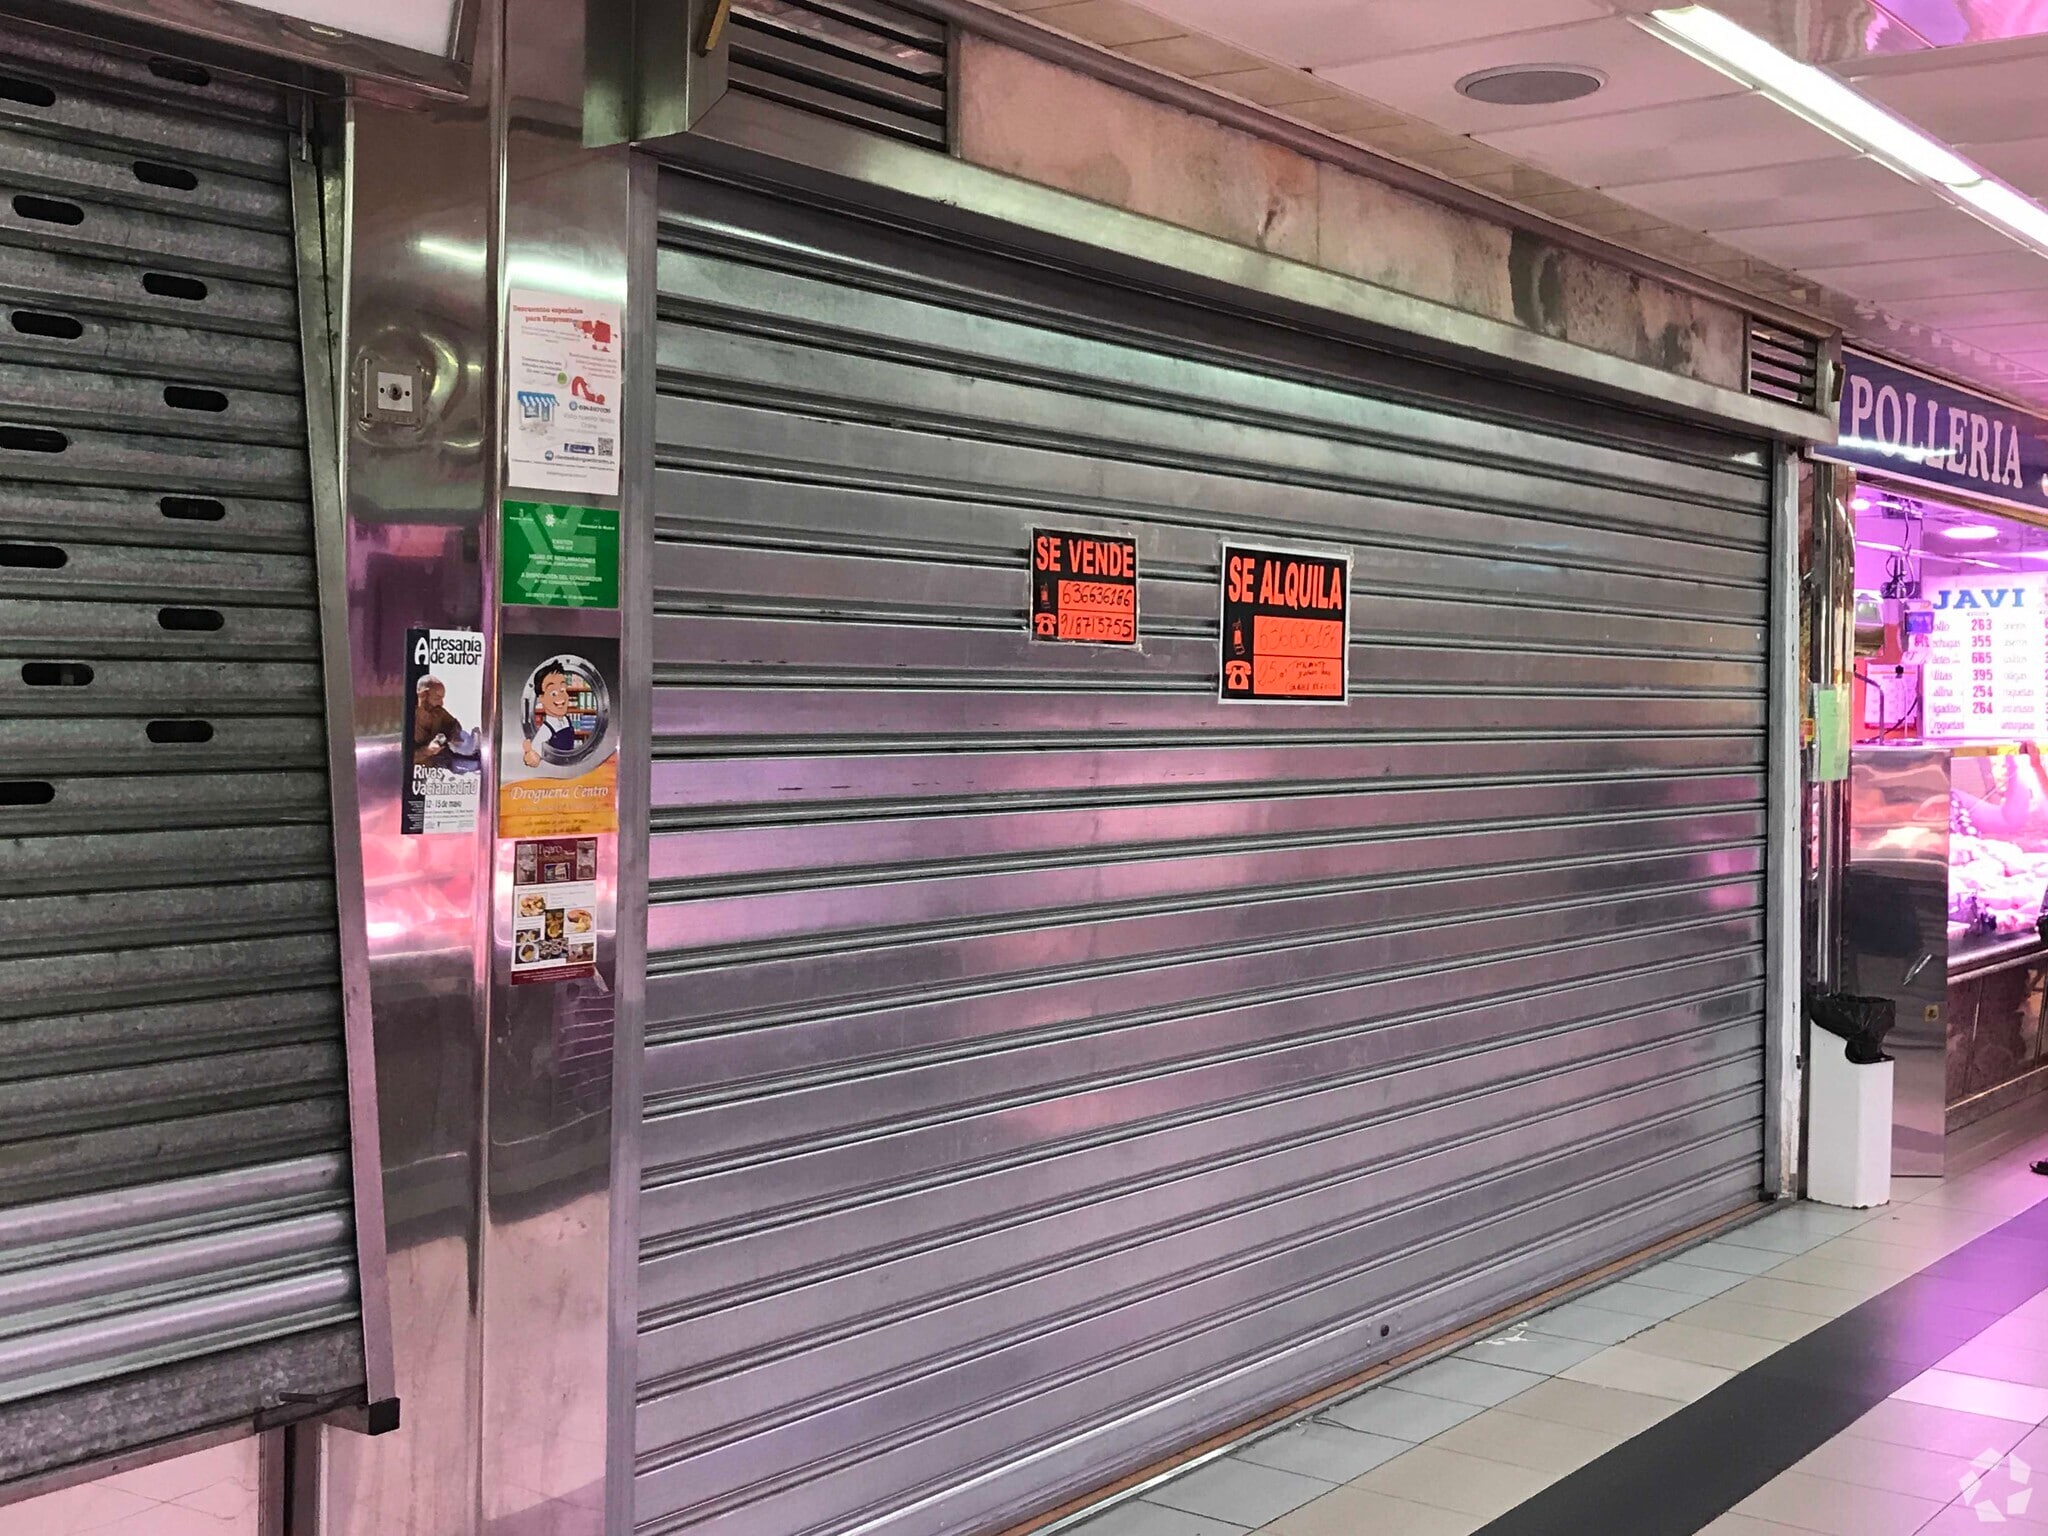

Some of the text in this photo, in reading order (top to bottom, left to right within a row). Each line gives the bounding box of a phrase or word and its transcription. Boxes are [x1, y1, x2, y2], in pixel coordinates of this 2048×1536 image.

[1850, 374, 2024, 489] POLLERIA
[1036, 536, 1135, 578] SE VENDE
[1228, 556, 1343, 611] SE ALQUILA
[1933, 587, 2026, 610] JAVI
[1933, 620, 1951, 632] ollo
[1971, 618, 1993, 632] 263
[1971, 634, 1992, 648] 355
[430, 649, 482, 666] de autor
[1972, 668, 1994, 681] 395
[1972, 684, 1994, 698] 254
[1972, 702, 1994, 714] 264
[413, 764, 444, 780] Rivas
[412, 780, 479, 796] Vaciamadrid
[574, 784, 609, 799] Centro
